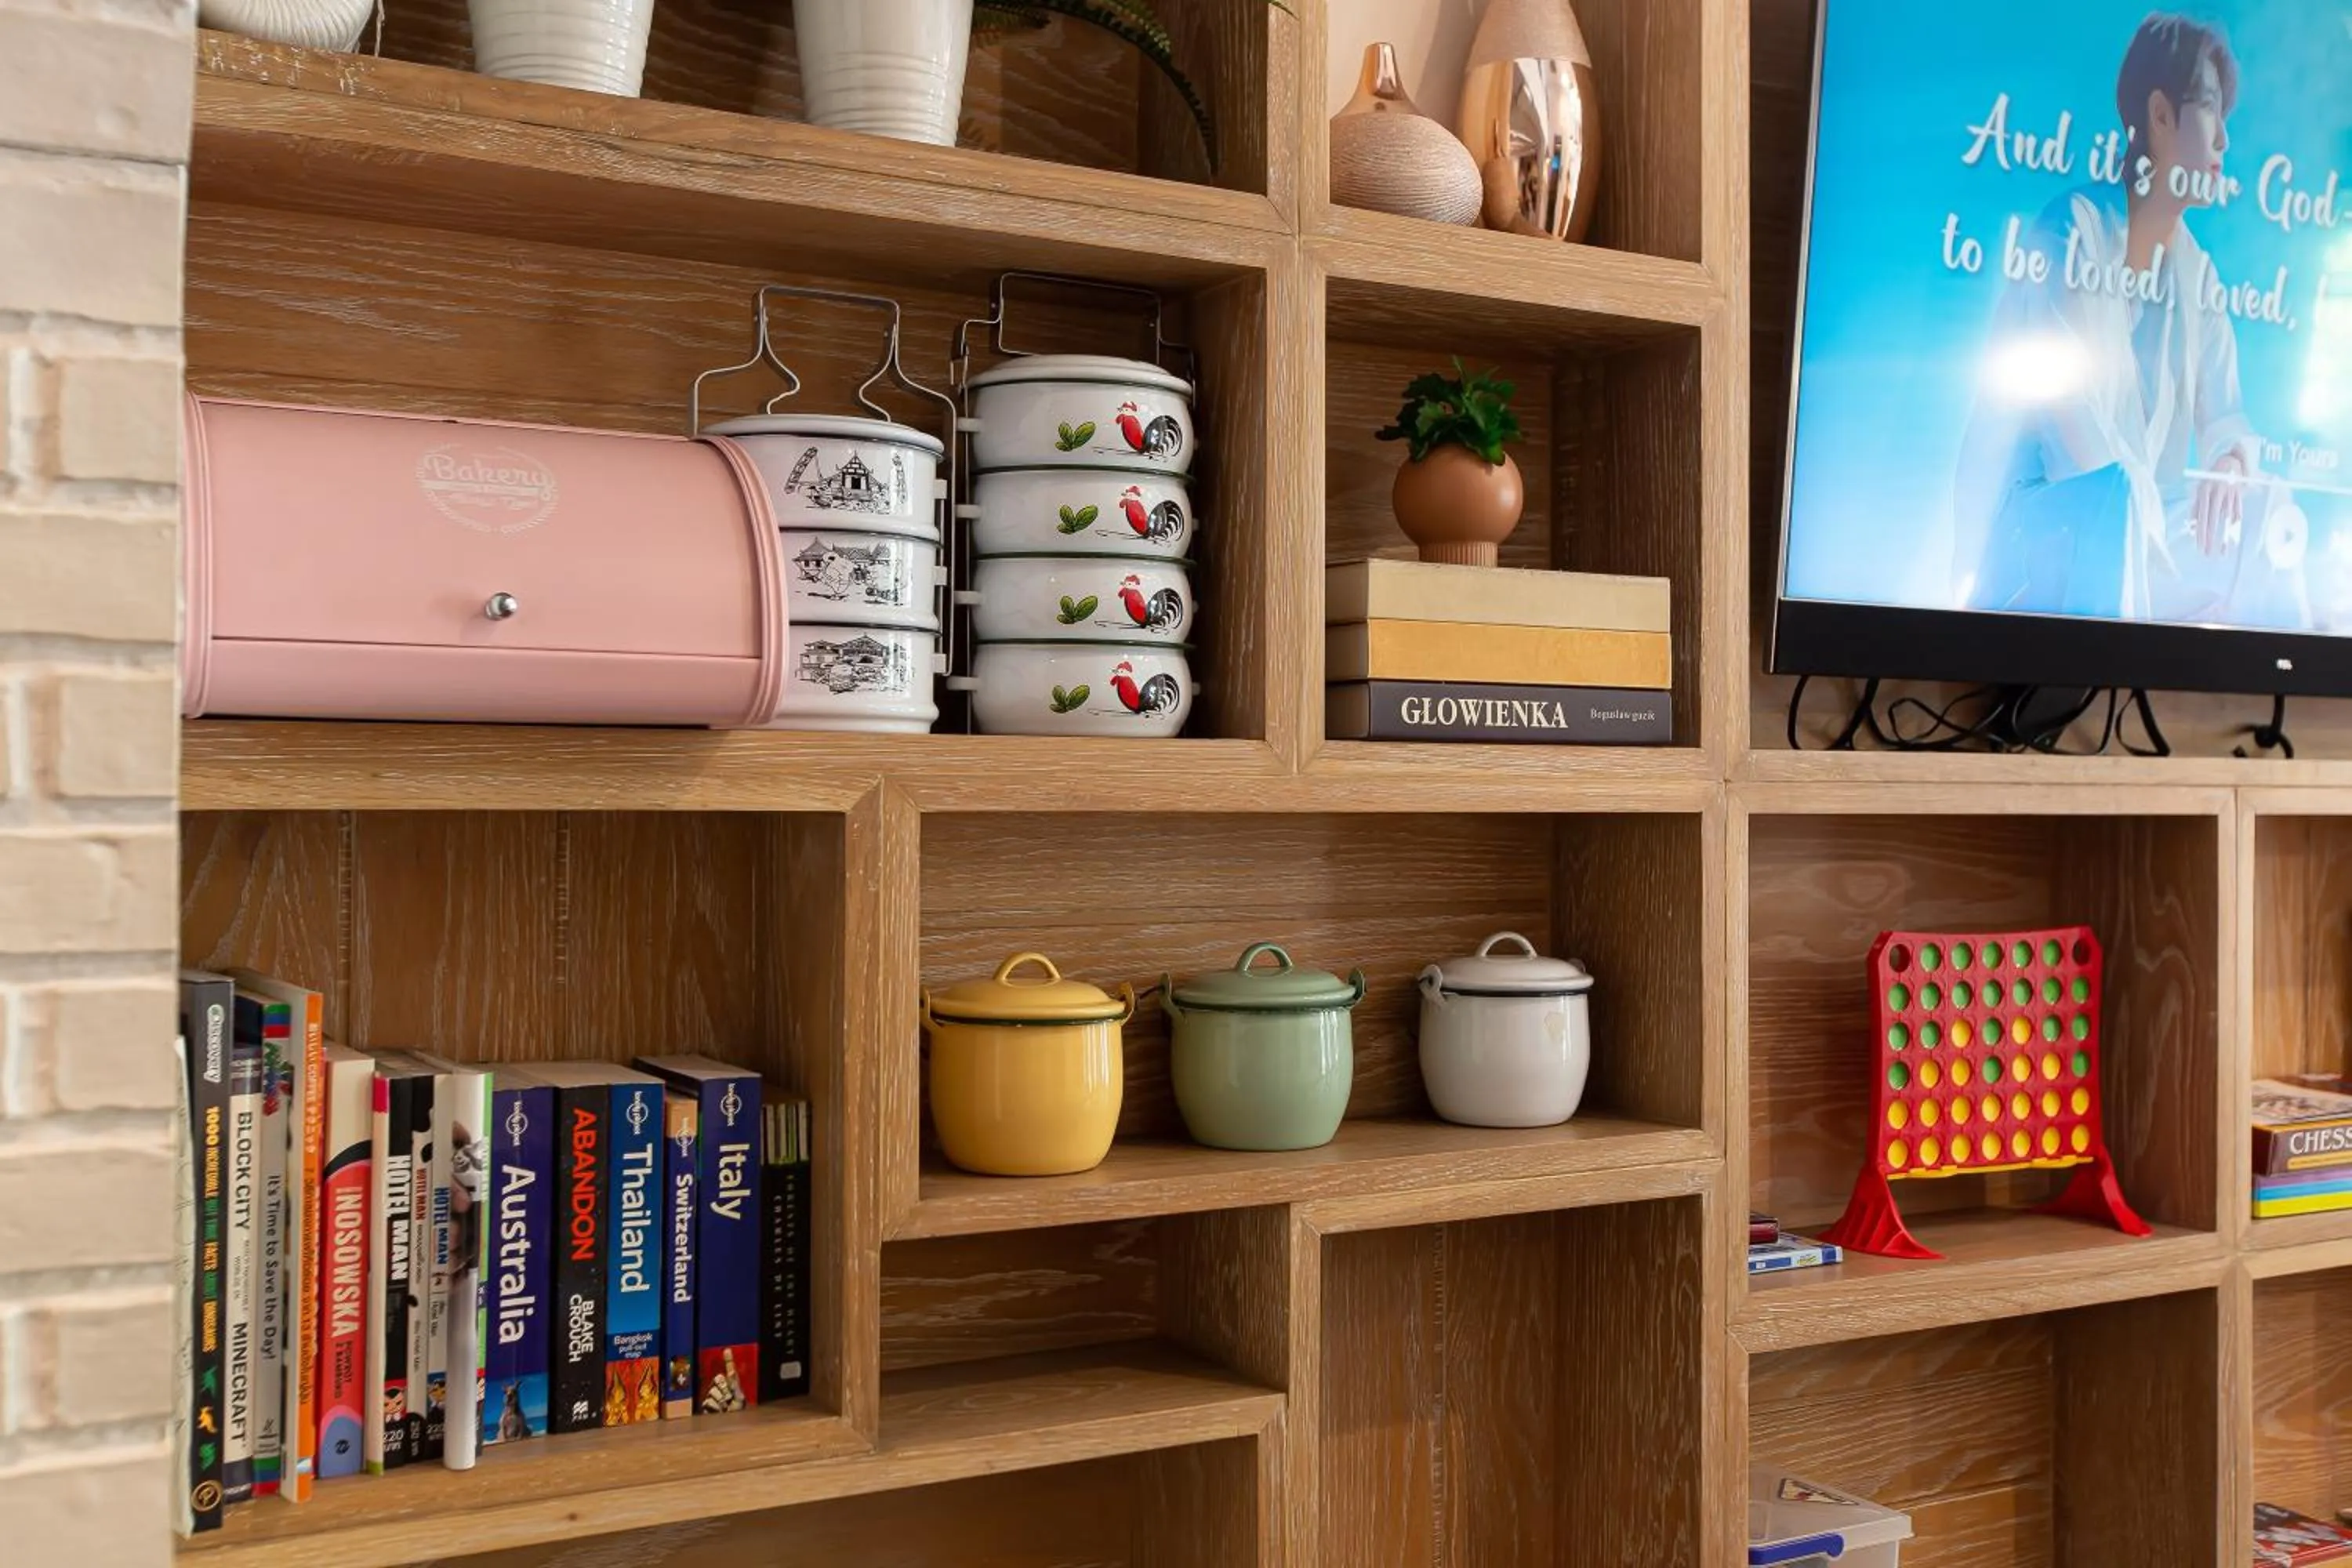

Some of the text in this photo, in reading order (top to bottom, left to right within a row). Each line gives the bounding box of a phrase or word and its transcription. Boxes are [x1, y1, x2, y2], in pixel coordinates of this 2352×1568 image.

[1961, 92, 2074, 172] And
[2089, 125, 2157, 197] it's
[2169, 164, 2242, 208] our
[1941, 212, 1984, 272] to
[2003, 216, 2051, 283] be
[2196, 252, 2296, 330] loved,
[424, 453, 554, 502] Bakery
[205, 1107, 220, 1145] 1000
[237, 1112, 252, 1178] BLOCK
[2290, 1127, 2352, 1155] CHESS
[236, 1185, 251, 1229] CITY
[385, 1155, 411, 1217] HOTEL
[416, 1169, 426, 1194] HOTEL
[416, 1196, 426, 1220] MAN
[571, 1108, 597, 1261] ABANDON
[711, 1143, 750, 1219] Italy
[392, 1219, 408, 1280] MAN
[434, 1189, 449, 1265] HOTEL MAN
[621, 1143, 652, 1293] Thailand
[673, 1174, 693, 1303] Switzerland
[261, 1176, 281, 1359] It's Time to Save the Day!
[332, 1187, 362, 1337] INOSOWSKA
[499, 1165, 535, 1344] Australia
[569, 1294, 582, 1363] CROUCH
[582, 1300, 593, 1354] BLAKE
[232, 1323, 249, 1442] MINECRAFT
